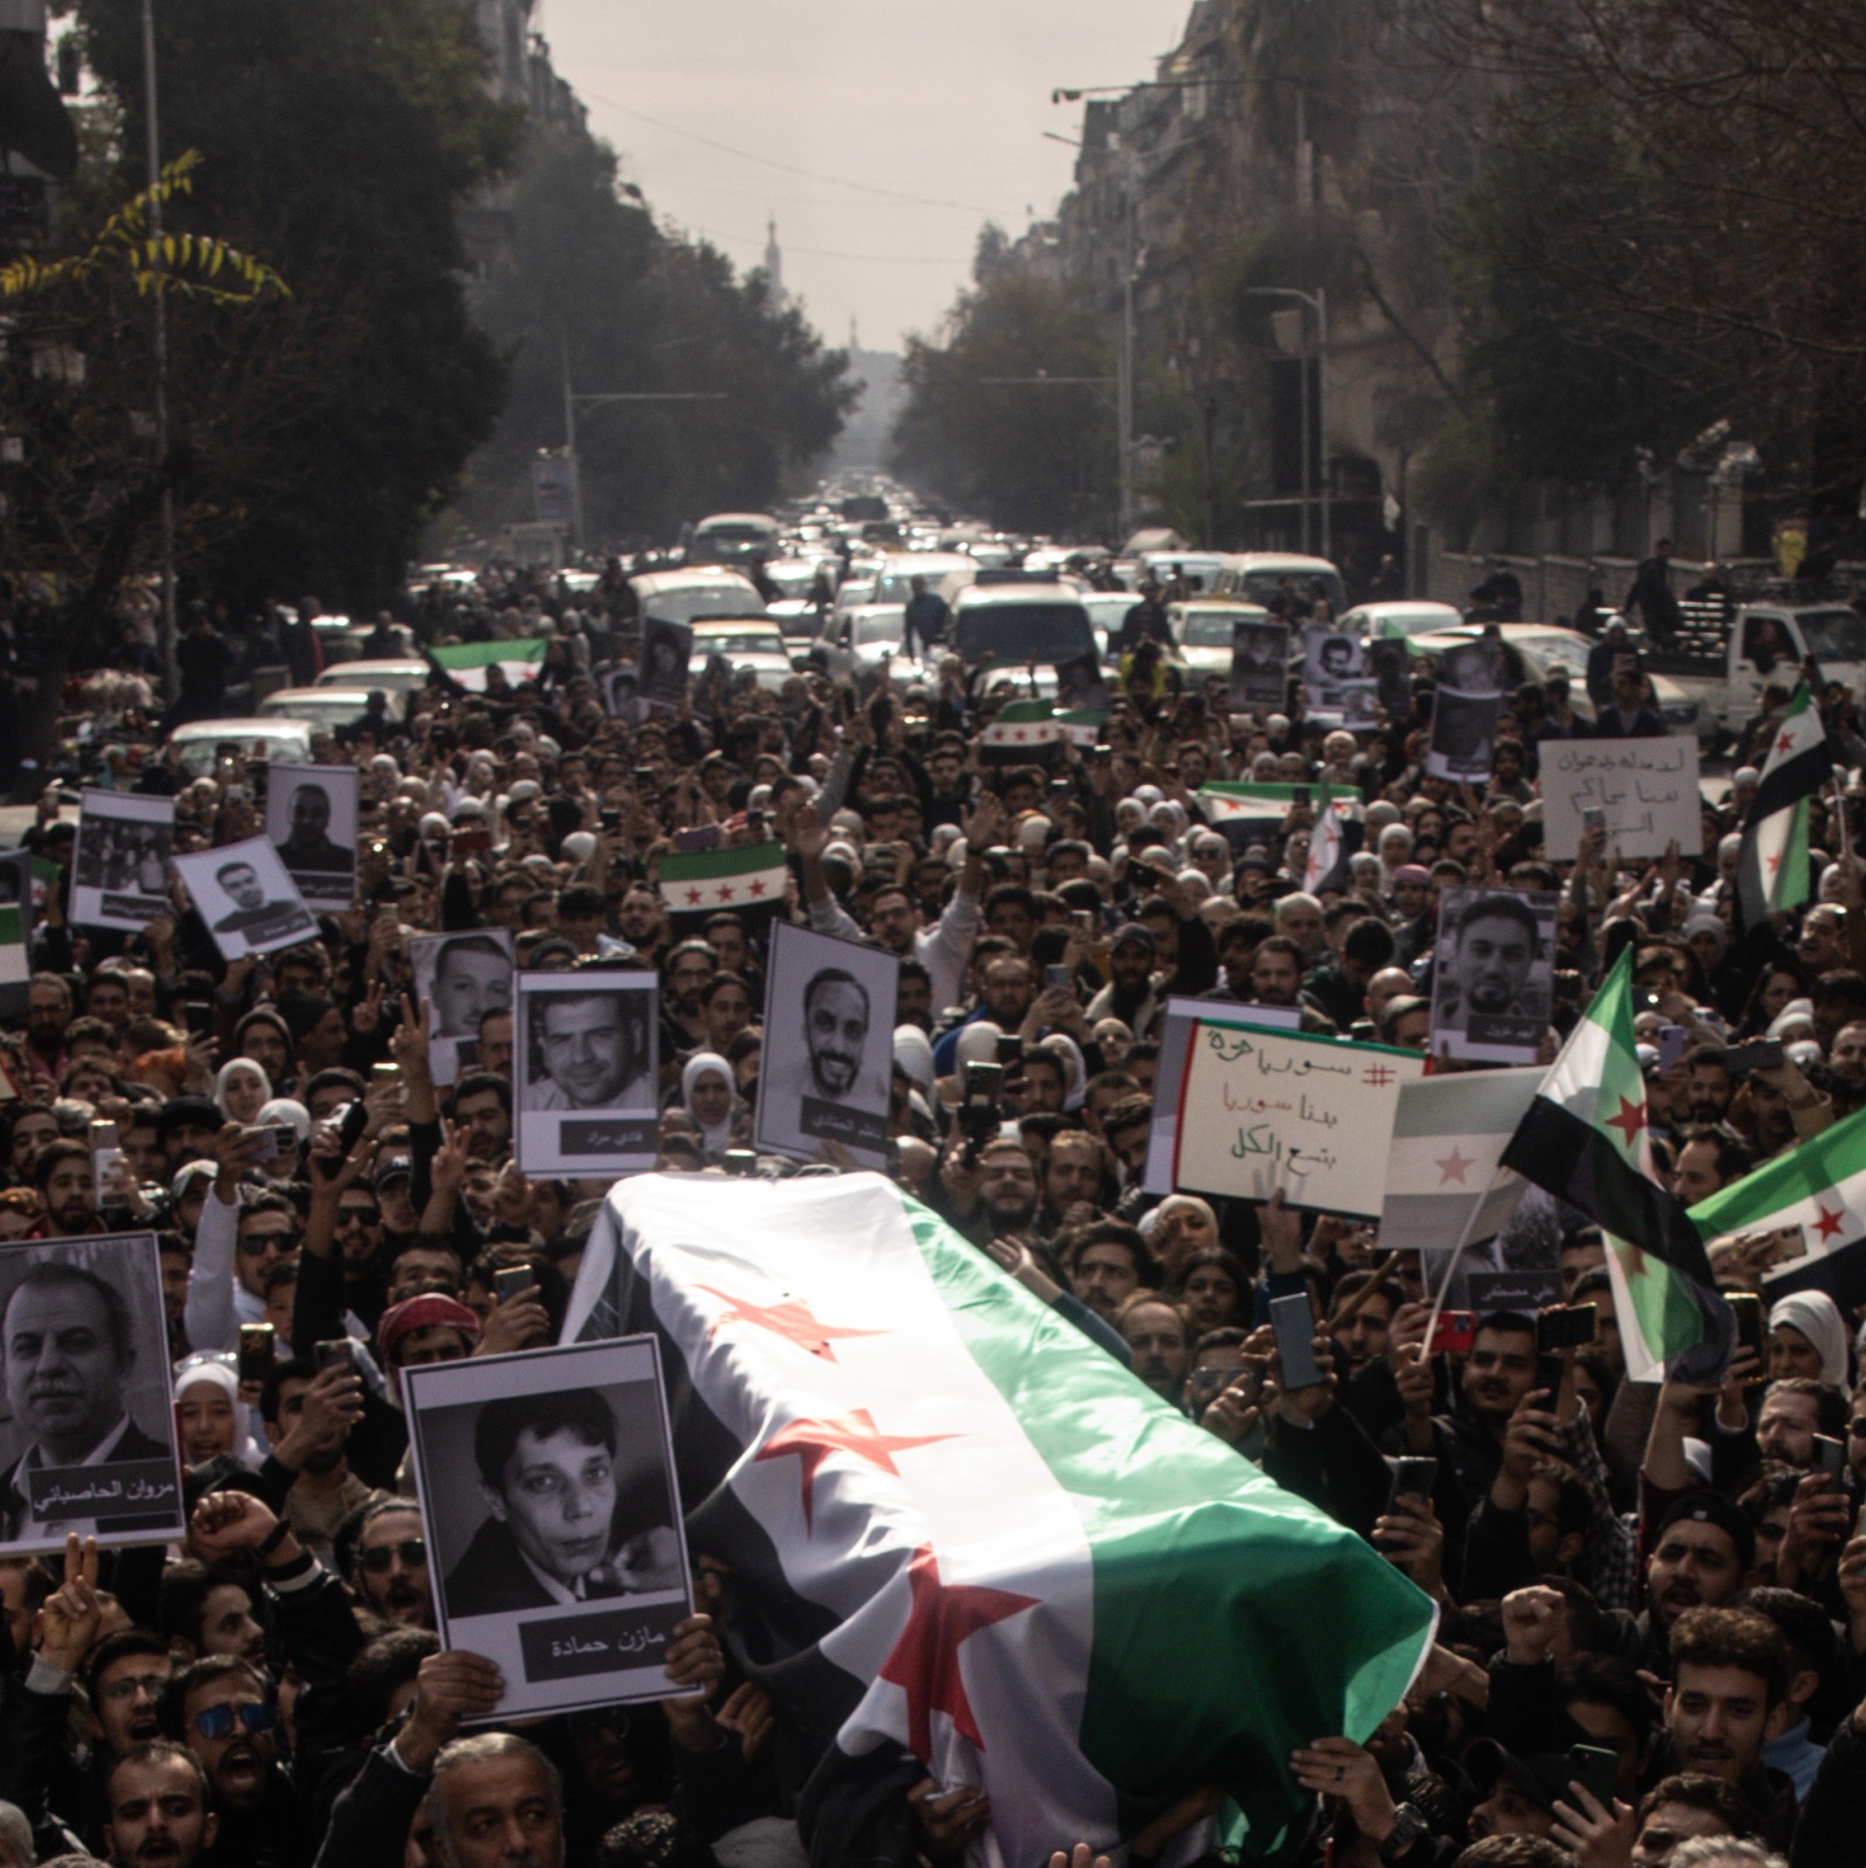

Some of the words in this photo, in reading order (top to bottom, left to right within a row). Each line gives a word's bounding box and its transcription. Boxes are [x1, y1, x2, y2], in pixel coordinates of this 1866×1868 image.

[1258, 1049, 1353, 1076] سوريا
[1222, 1082, 1293, 1112] سوريا
[1299, 1093, 1338, 1129] بدنا
[1230, 1123, 1282, 1161] الكل
[1286, 1148, 1337, 1177] بتسع
[1480, 1282, 1529, 1302] مصطفى
[1532, 1282, 1556, 1304] علي
[34, 1479, 123, 1513] الحاصباني
[126, 1478, 176, 1502] مروان
[551, 1634, 610, 1657] حمادة
[617, 1625, 666, 1653] مازن
